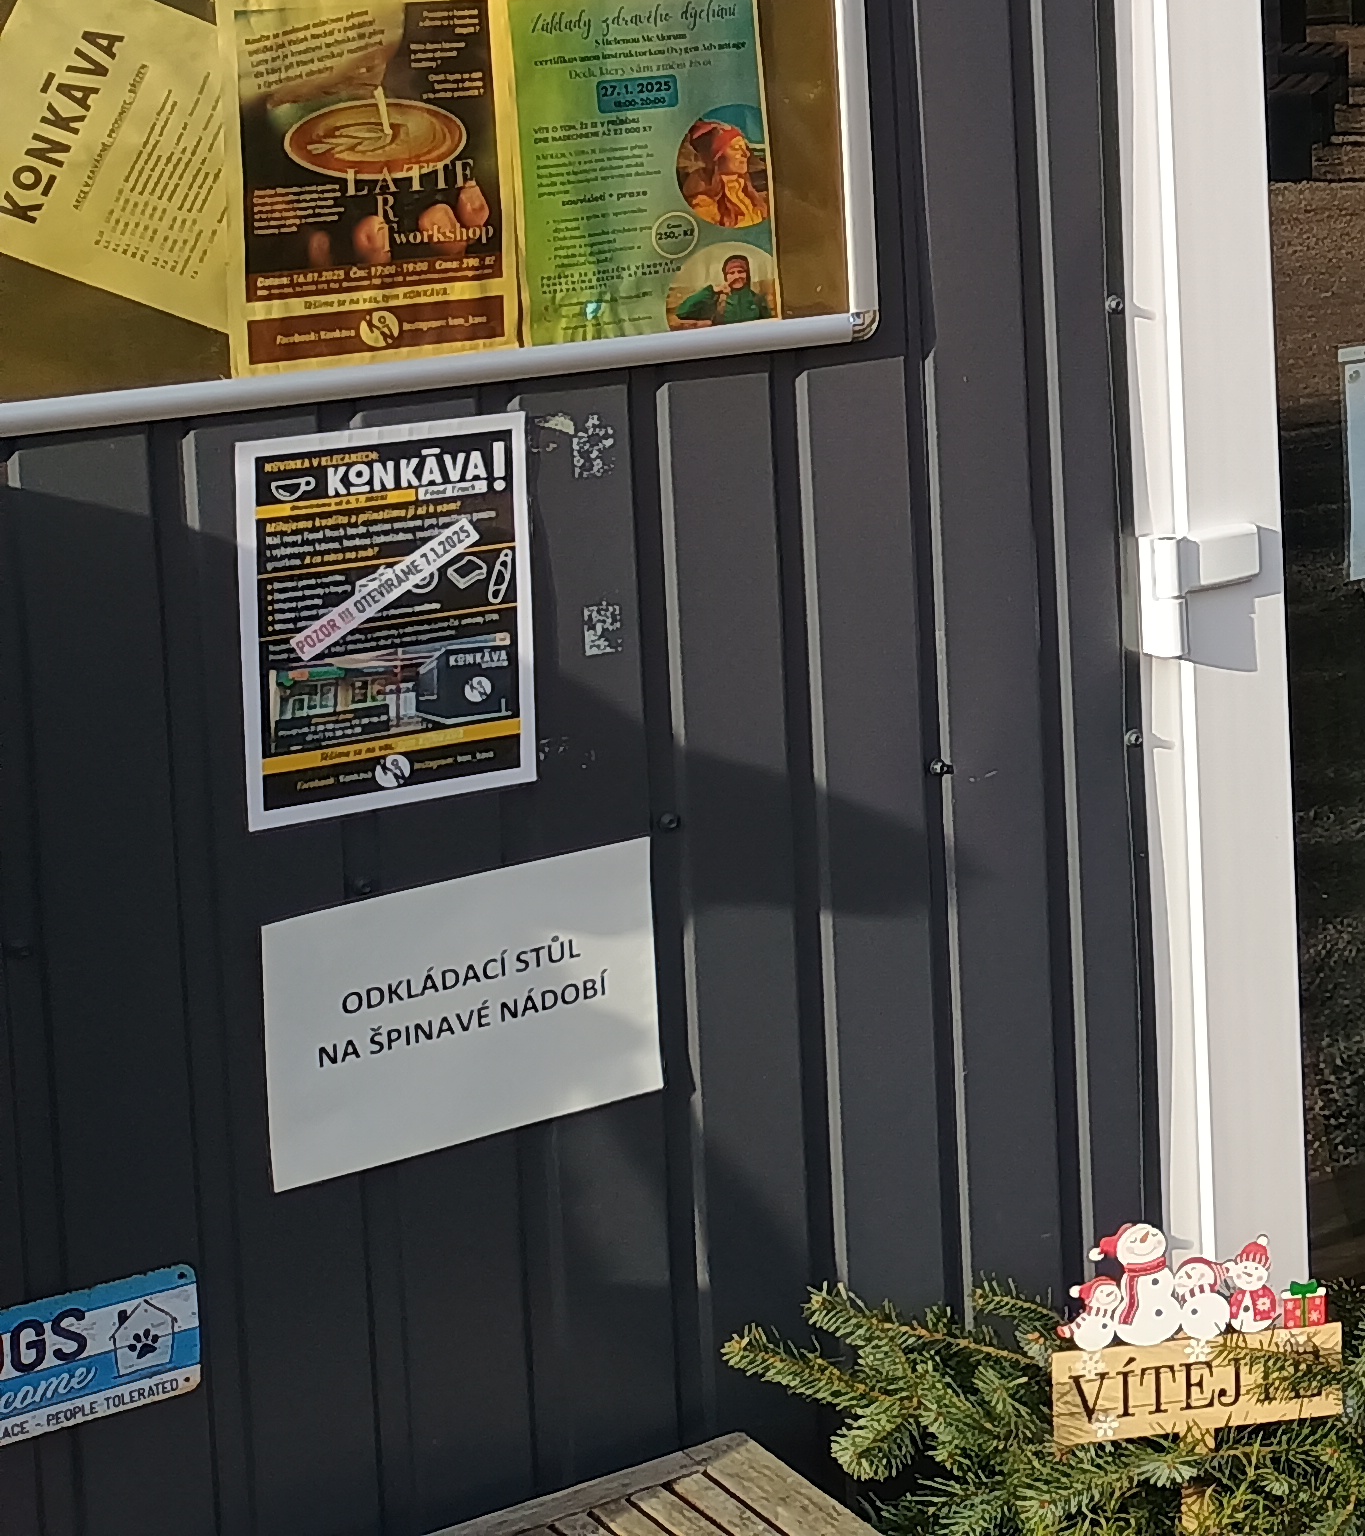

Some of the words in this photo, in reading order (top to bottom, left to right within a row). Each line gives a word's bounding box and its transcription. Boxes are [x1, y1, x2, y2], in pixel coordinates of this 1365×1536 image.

[601, 84, 621, 98] 27.
[623, 83, 634, 95] 1.
[637, 80, 672, 94] 2025
[345, 158, 475, 197] LATTE
[393, 224, 494, 245] workshop
[295, 616, 340, 656] POZOR
[341, 950, 509, 1015] ODKLÁDACÍ
[514, 935, 582, 974] STŮL
[317, 1038, 362, 1068] NA
[368, 1000, 492, 1057] ŠPINAVÉ
[498, 968, 610, 1023] NÁDOBÍ
[0, 1307, 88, 1376] GS
[0, 1420, 30, 1441] ACE
[46, 1401, 99, 1427] PEOPLE
[103, 1377, 179, 1411] TOLERATED
